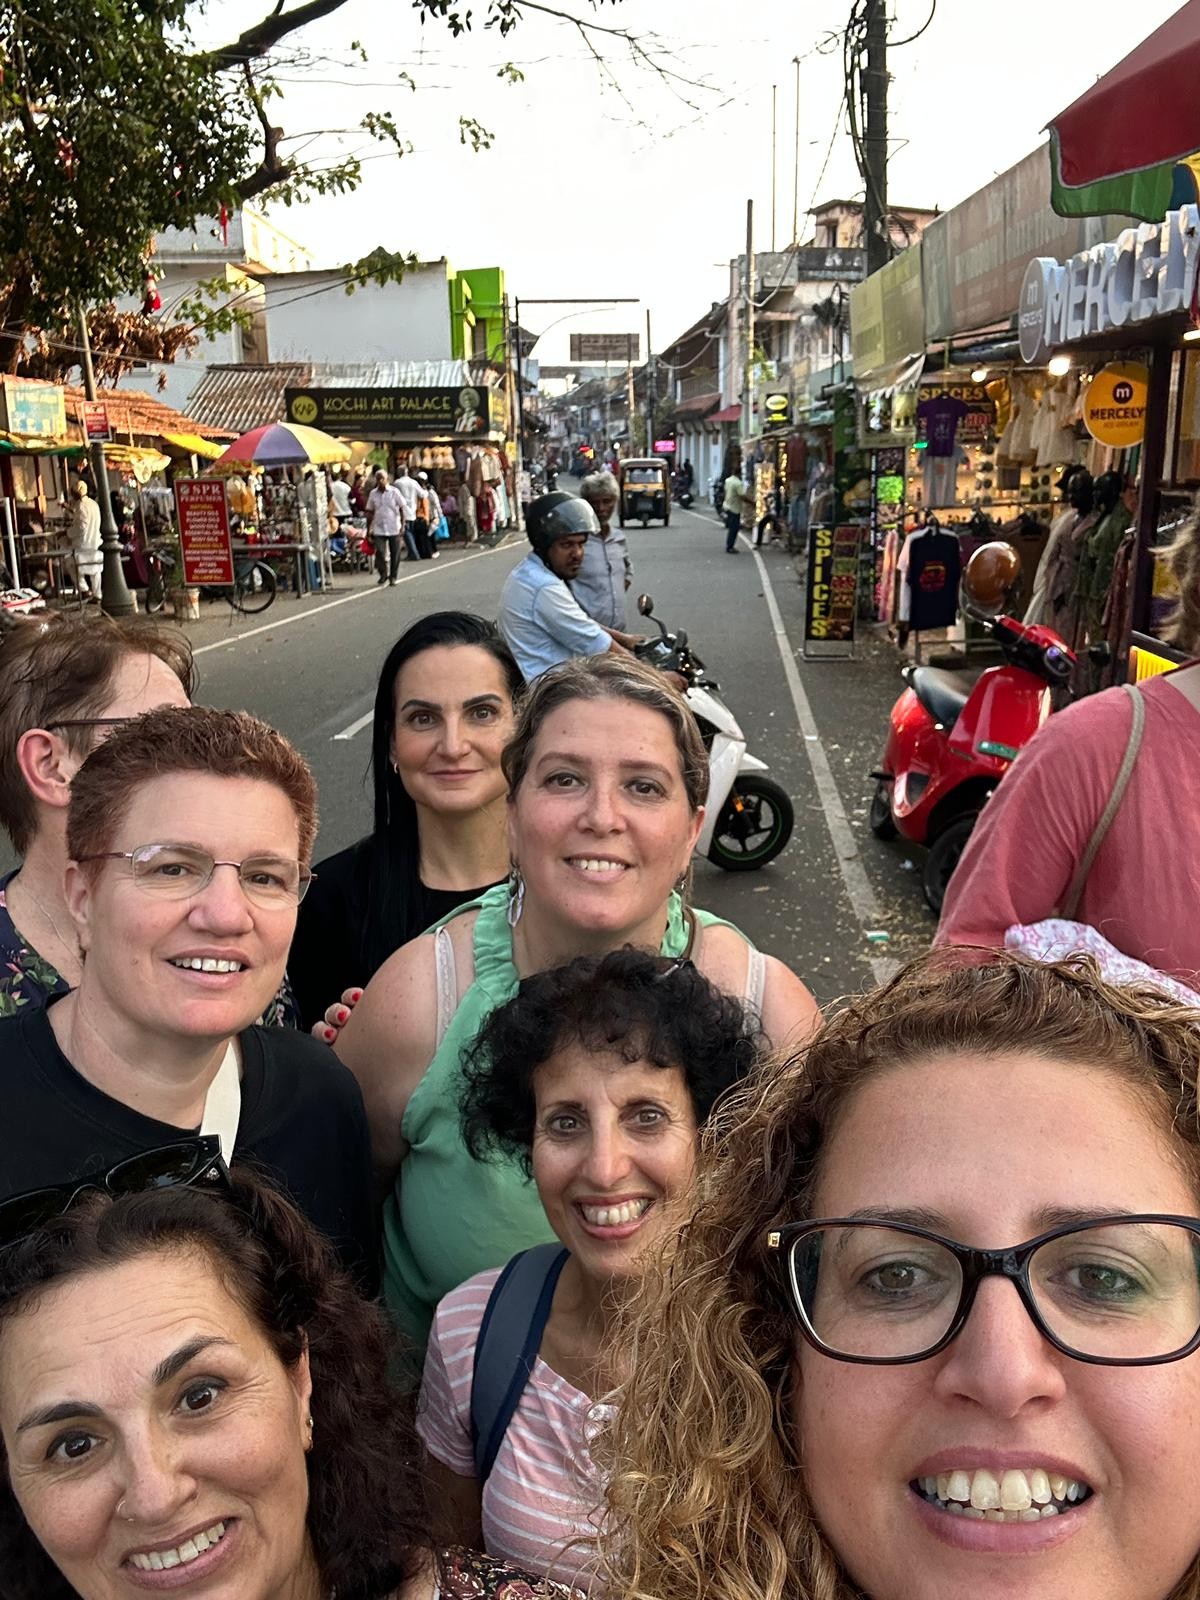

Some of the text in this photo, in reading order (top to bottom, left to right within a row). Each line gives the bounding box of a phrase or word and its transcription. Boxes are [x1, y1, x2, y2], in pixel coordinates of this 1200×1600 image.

[919, 387, 985, 400] SPCES
[1116, 387, 1130, 398] m
[323, 396, 452, 411] KOCHI ART PALACE
[1090, 407, 1145, 420] MERCELY
[192, 484, 220, 495] SPR
[811, 529, 832, 636] SPICES
